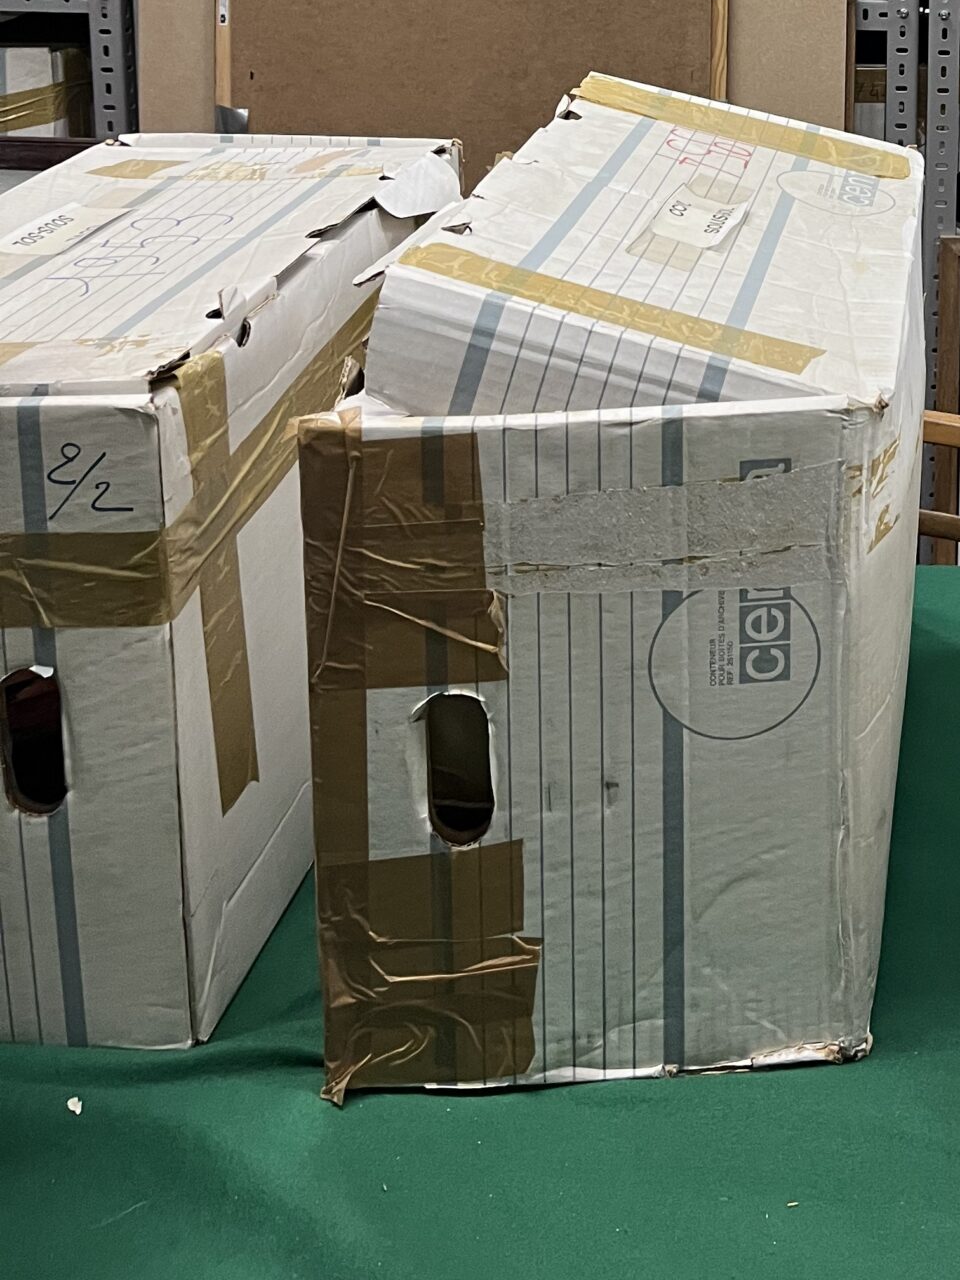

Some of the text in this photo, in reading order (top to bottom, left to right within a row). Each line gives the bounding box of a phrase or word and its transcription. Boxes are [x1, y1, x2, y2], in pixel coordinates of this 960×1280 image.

[838, 170, 881, 208] cen
[11, 213, 75, 247] SOUS-SOL
[47, 442, 134, 521] 2/2
[709, 637, 717, 687] CONTENEUR
[718, 664, 726, 686] POUR
